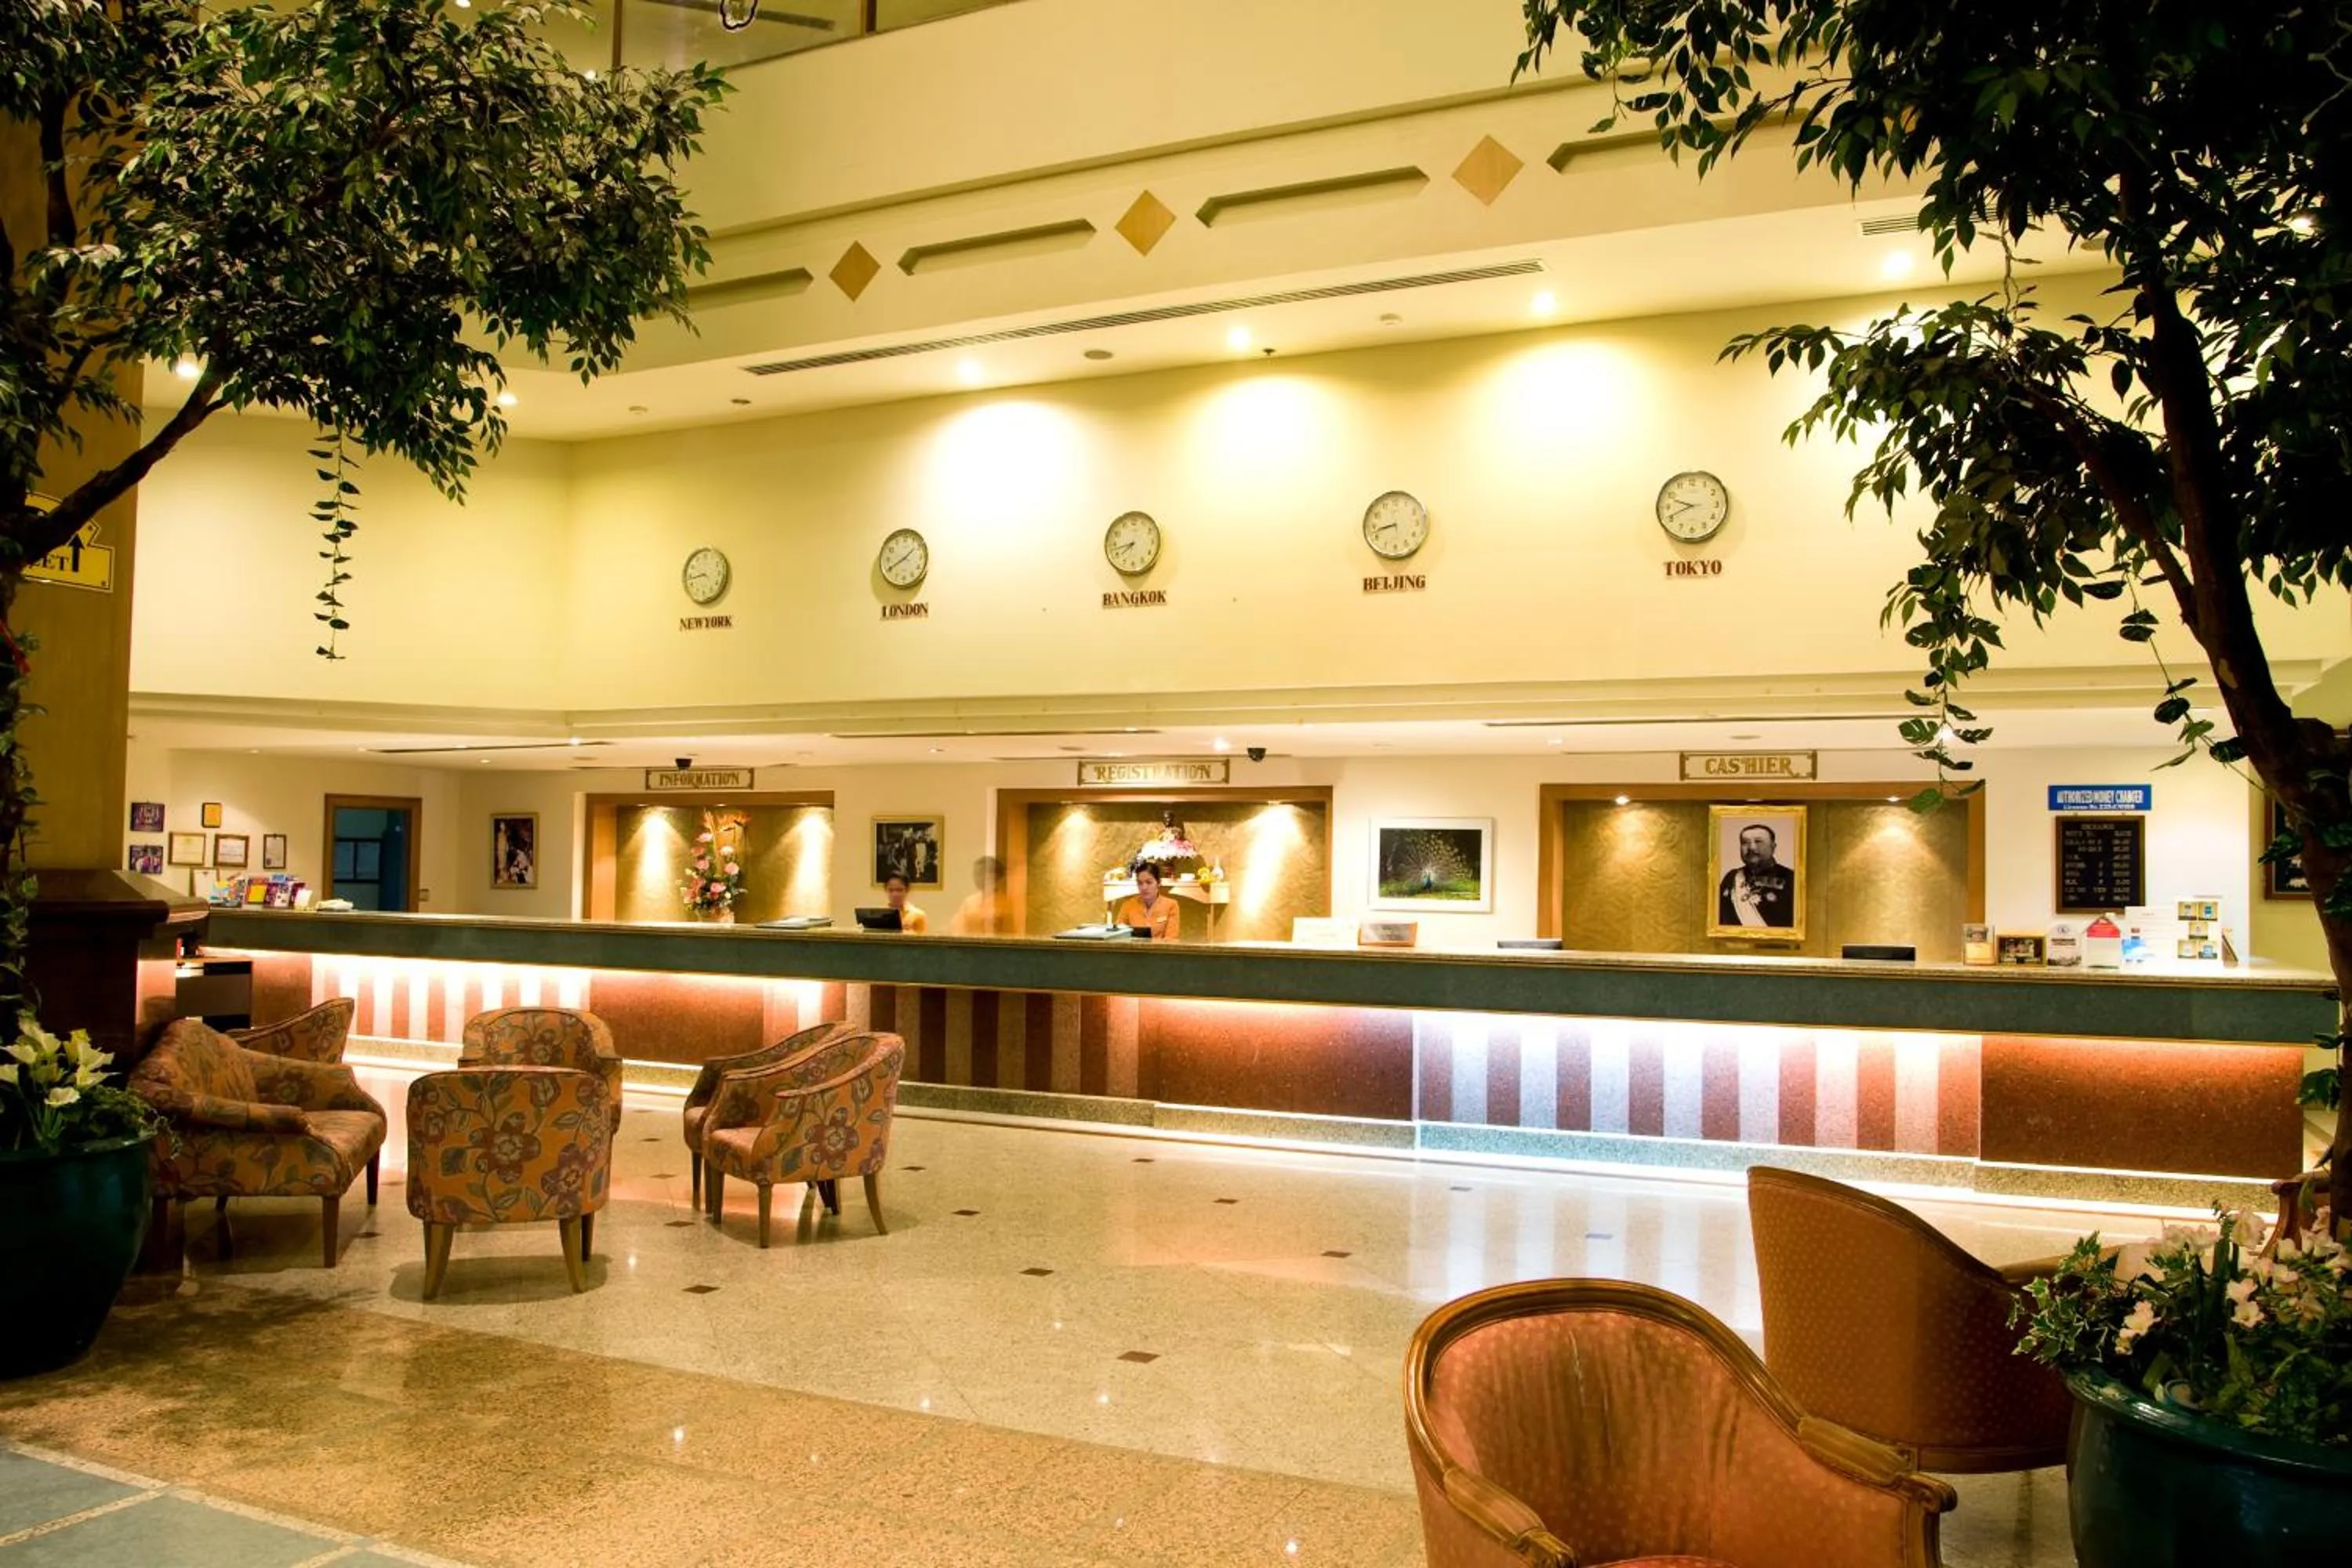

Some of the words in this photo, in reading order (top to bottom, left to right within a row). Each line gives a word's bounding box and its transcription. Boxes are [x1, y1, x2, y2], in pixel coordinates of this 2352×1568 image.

[1664, 560, 1722, 575] TOKYO
[1363, 575, 1426, 590] BEIJING
[1102, 590, 1166, 606] BANGKOK
[882, 603, 928, 618] LONDON
[1705, 757, 1799, 777] CASHIER
[659, 771, 739, 788] INFORMATION
